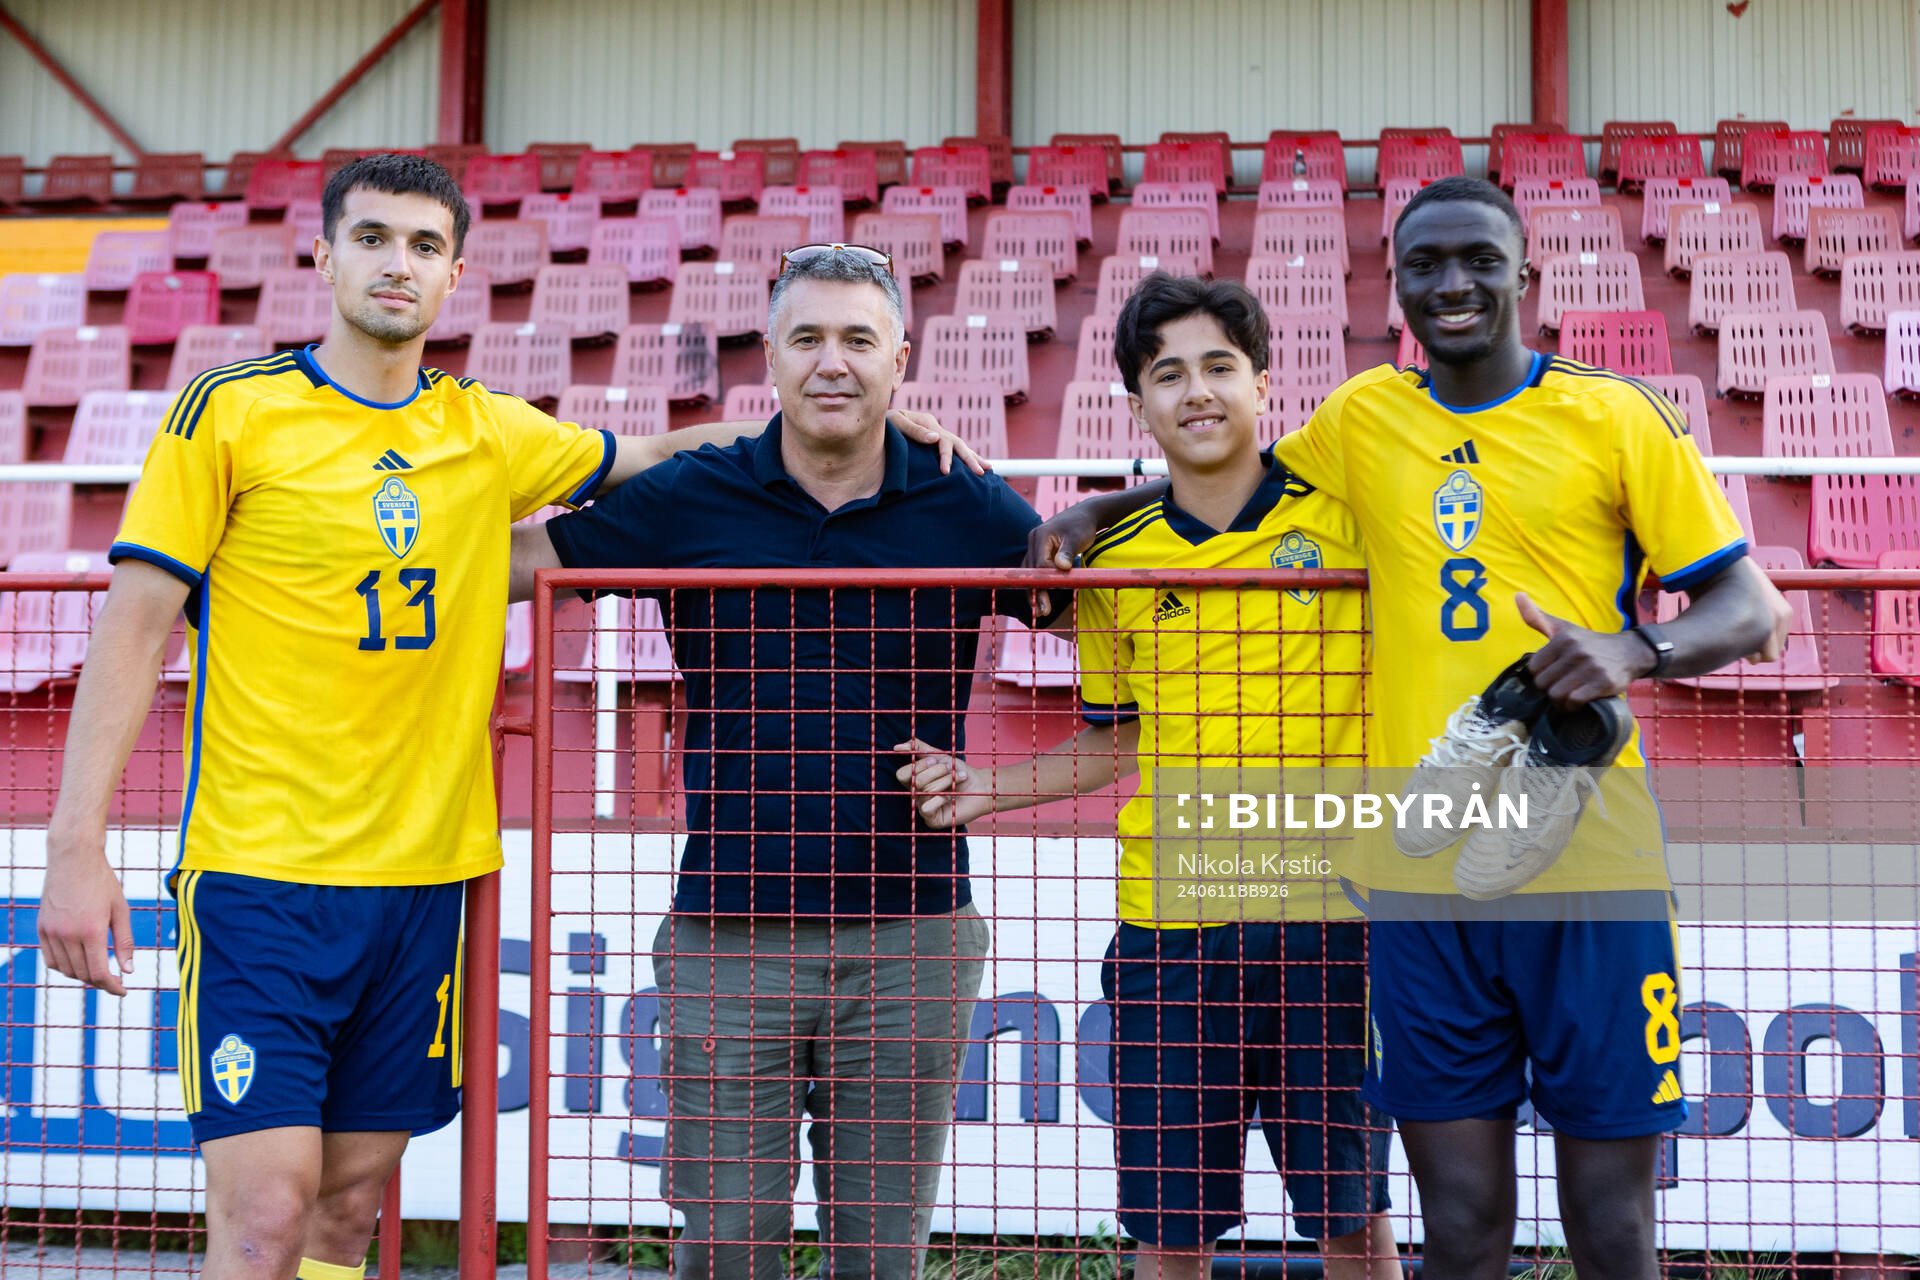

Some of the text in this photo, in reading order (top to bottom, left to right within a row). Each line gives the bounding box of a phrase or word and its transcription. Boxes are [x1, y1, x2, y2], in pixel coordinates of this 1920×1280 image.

[356, 568, 436, 651] 13
[1152, 606, 1191, 623] adidas
[1440, 558, 1490, 642] 8
[1641, 972, 1681, 1065] 8
